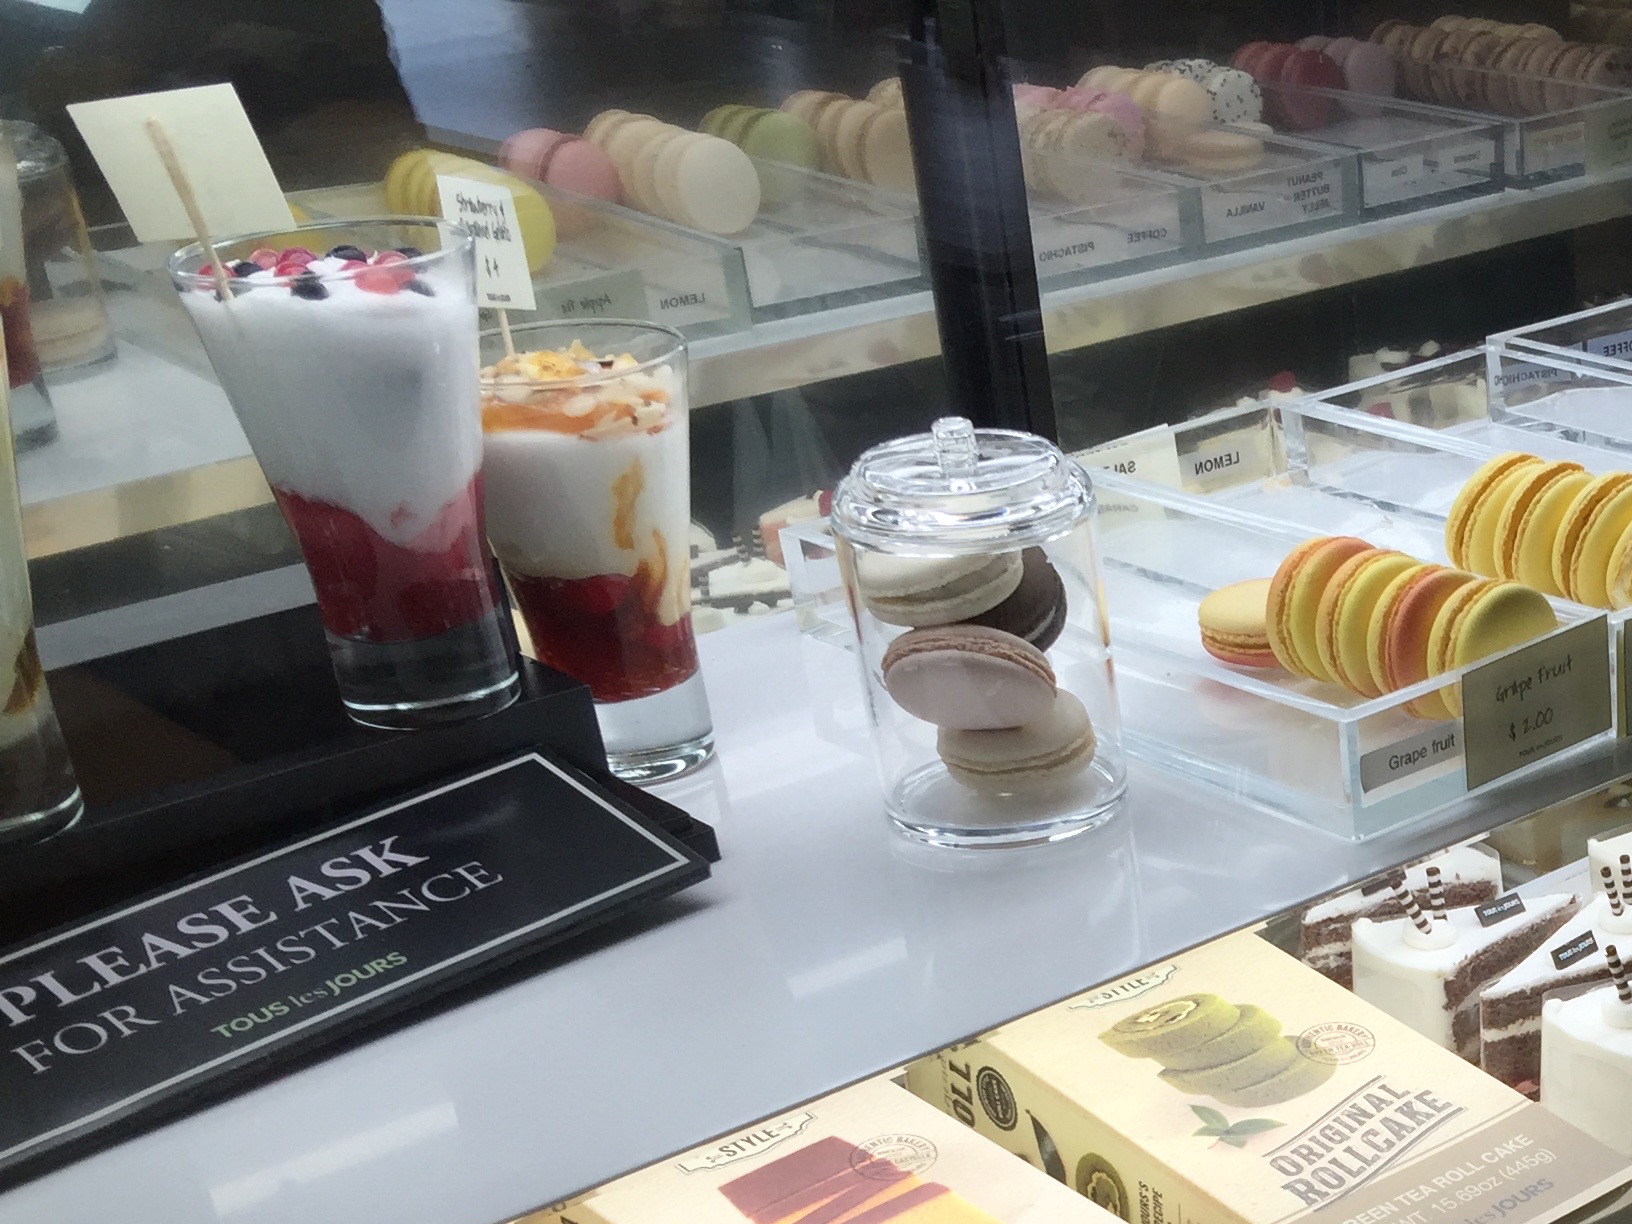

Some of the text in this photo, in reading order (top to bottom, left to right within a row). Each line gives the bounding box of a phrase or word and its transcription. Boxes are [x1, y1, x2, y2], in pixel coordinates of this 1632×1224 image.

[1538, 653, 1573, 683] Fruit
[1388, 732, 1456, 771] Grape fruit
[1522, 707, 1554, 734] 2.00
[0, 834, 430, 1027] PLEASE ASK
[12, 861, 504, 1075] FOR ASSISTANCE
[210, 951, 409, 1041] TOUS les JOURS
[719, 1126, 779, 1159] STYLE
[1269, 1080, 1411, 1178] ORIGINAL
[1280, 1088, 1453, 1212] ROLLCAKE
[1397, 1184, 1439, 1211] TEA
[1431, 1161, 1486, 1189] ROLL
[1480, 1133, 1535, 1165] CAKE
[1431, 1176, 1503, 1216] 15.69oz
[1498, 1147, 1557, 1181] (445g)
[1491, 1177, 1556, 1218] JOURS
